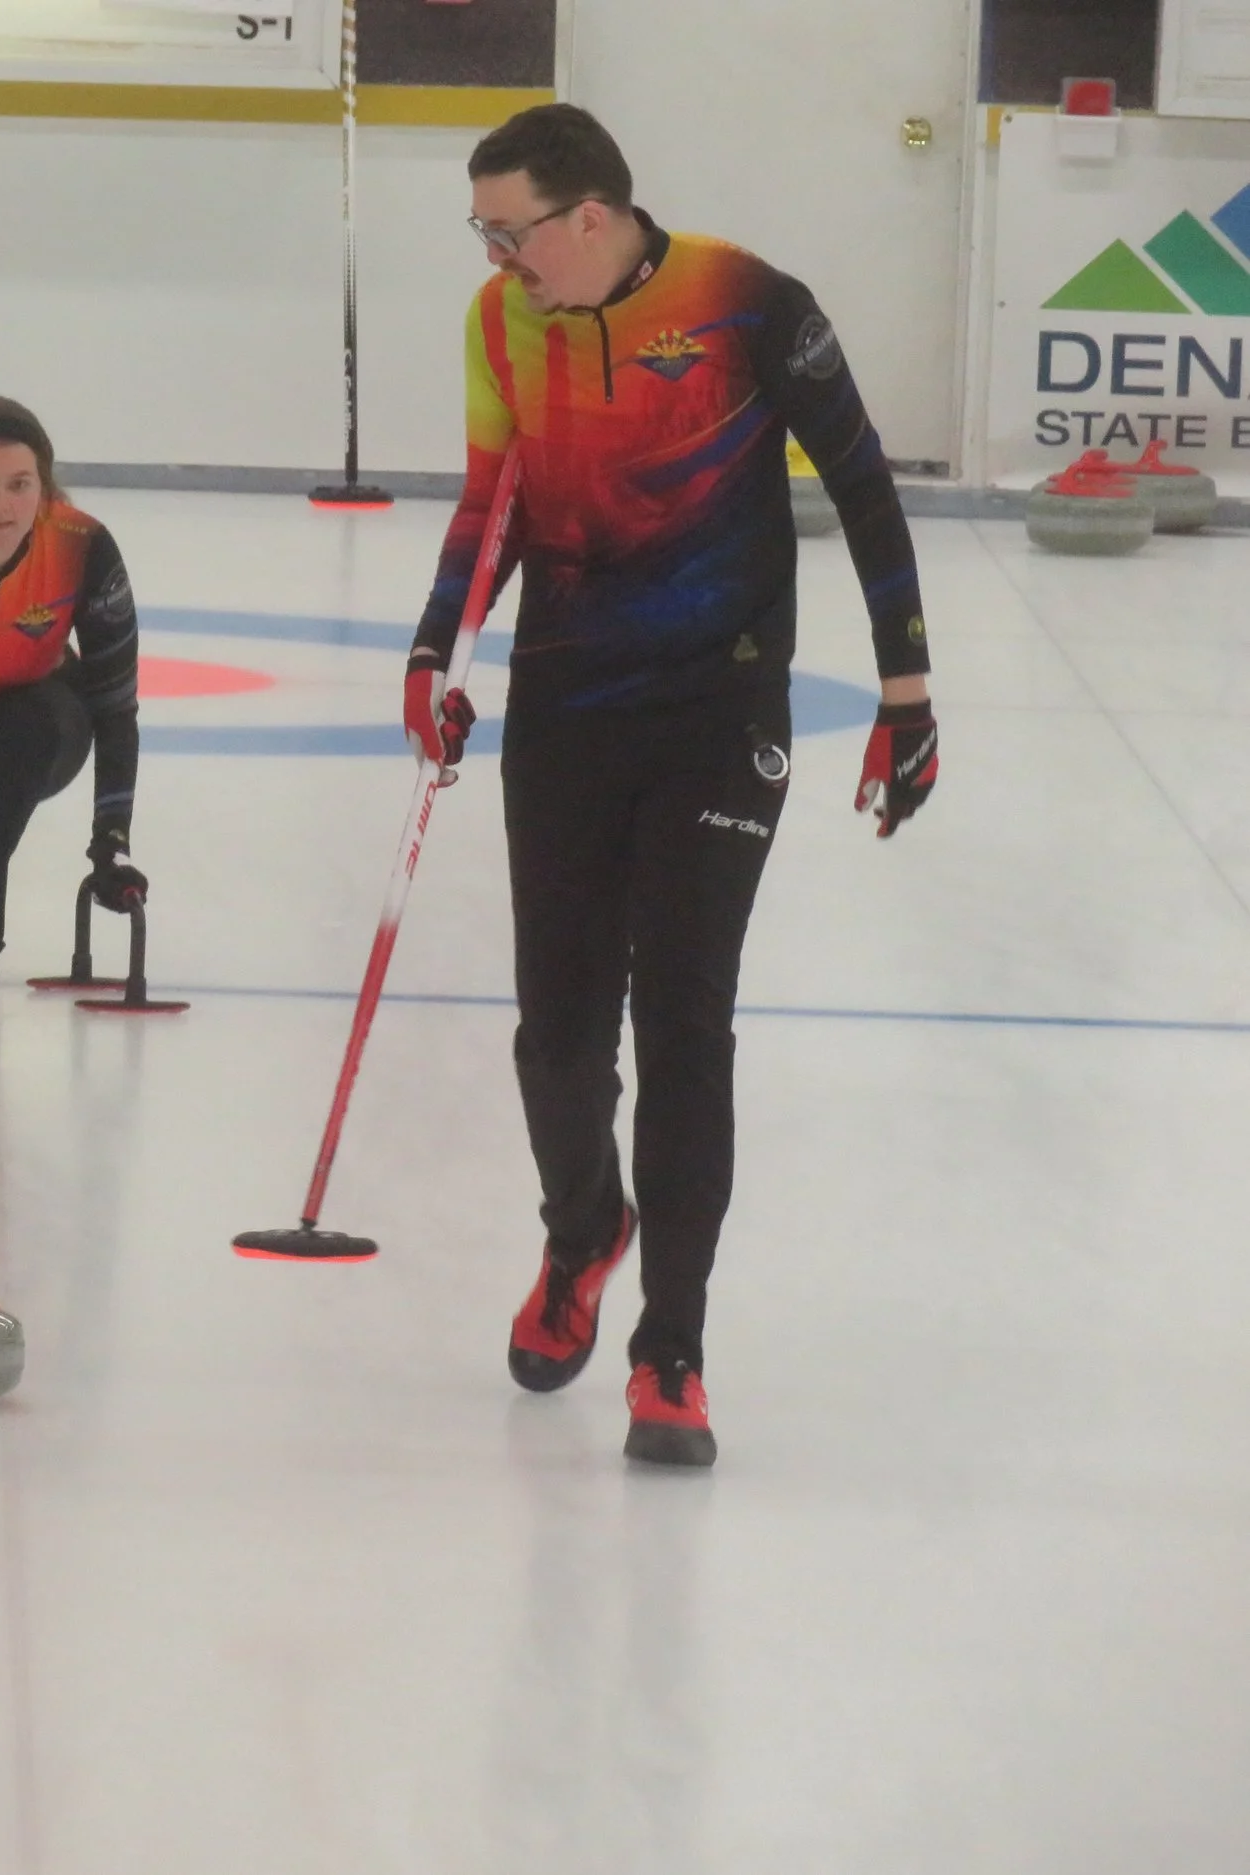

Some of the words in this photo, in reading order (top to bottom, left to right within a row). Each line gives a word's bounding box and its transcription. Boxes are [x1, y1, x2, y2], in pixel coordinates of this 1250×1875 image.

[1036, 330, 1250, 399] DEN
[1034, 409, 1207, 448] STATE
[698, 809, 770, 838] Hardline
